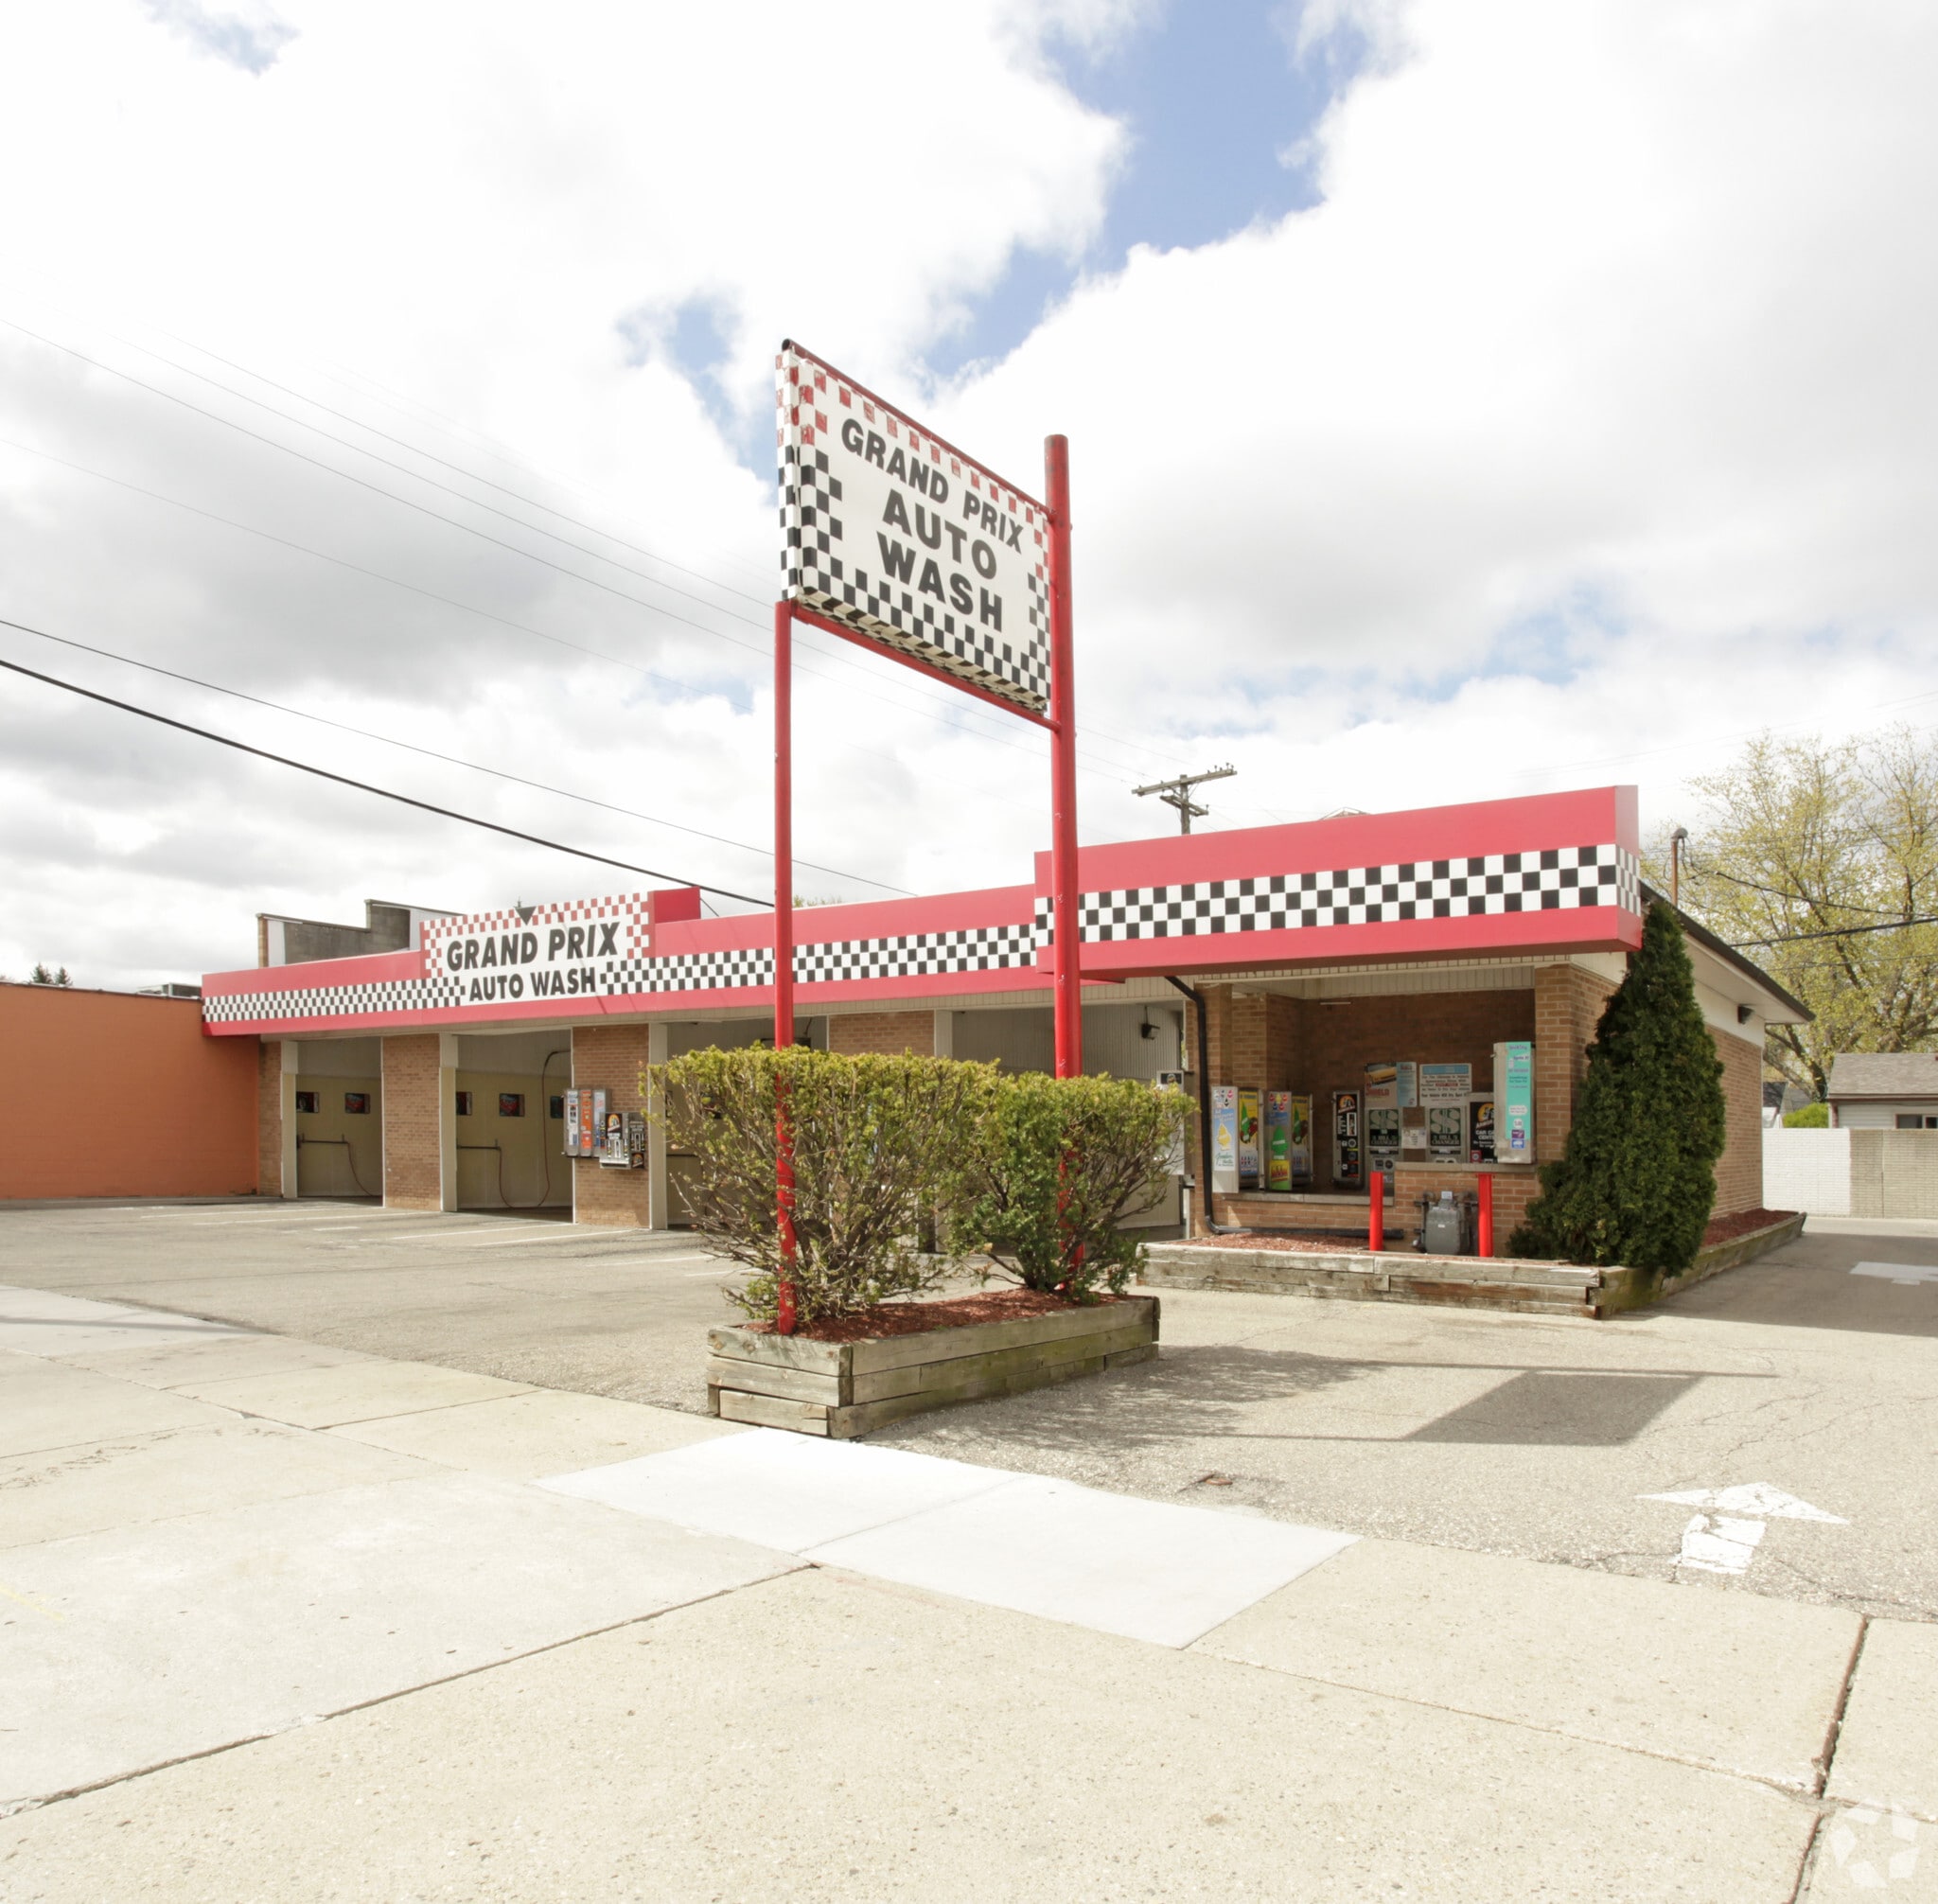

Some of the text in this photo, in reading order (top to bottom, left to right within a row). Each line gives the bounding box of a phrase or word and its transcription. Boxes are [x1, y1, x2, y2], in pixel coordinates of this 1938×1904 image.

[840, 417, 1025, 554] GRAND PRIX
[882, 489, 998, 581] AUTO
[876, 530, 1003, 634] WASH
[447, 921, 621, 972] GRAND PRIX
[469, 966, 596, 1002] AUTO WASH
